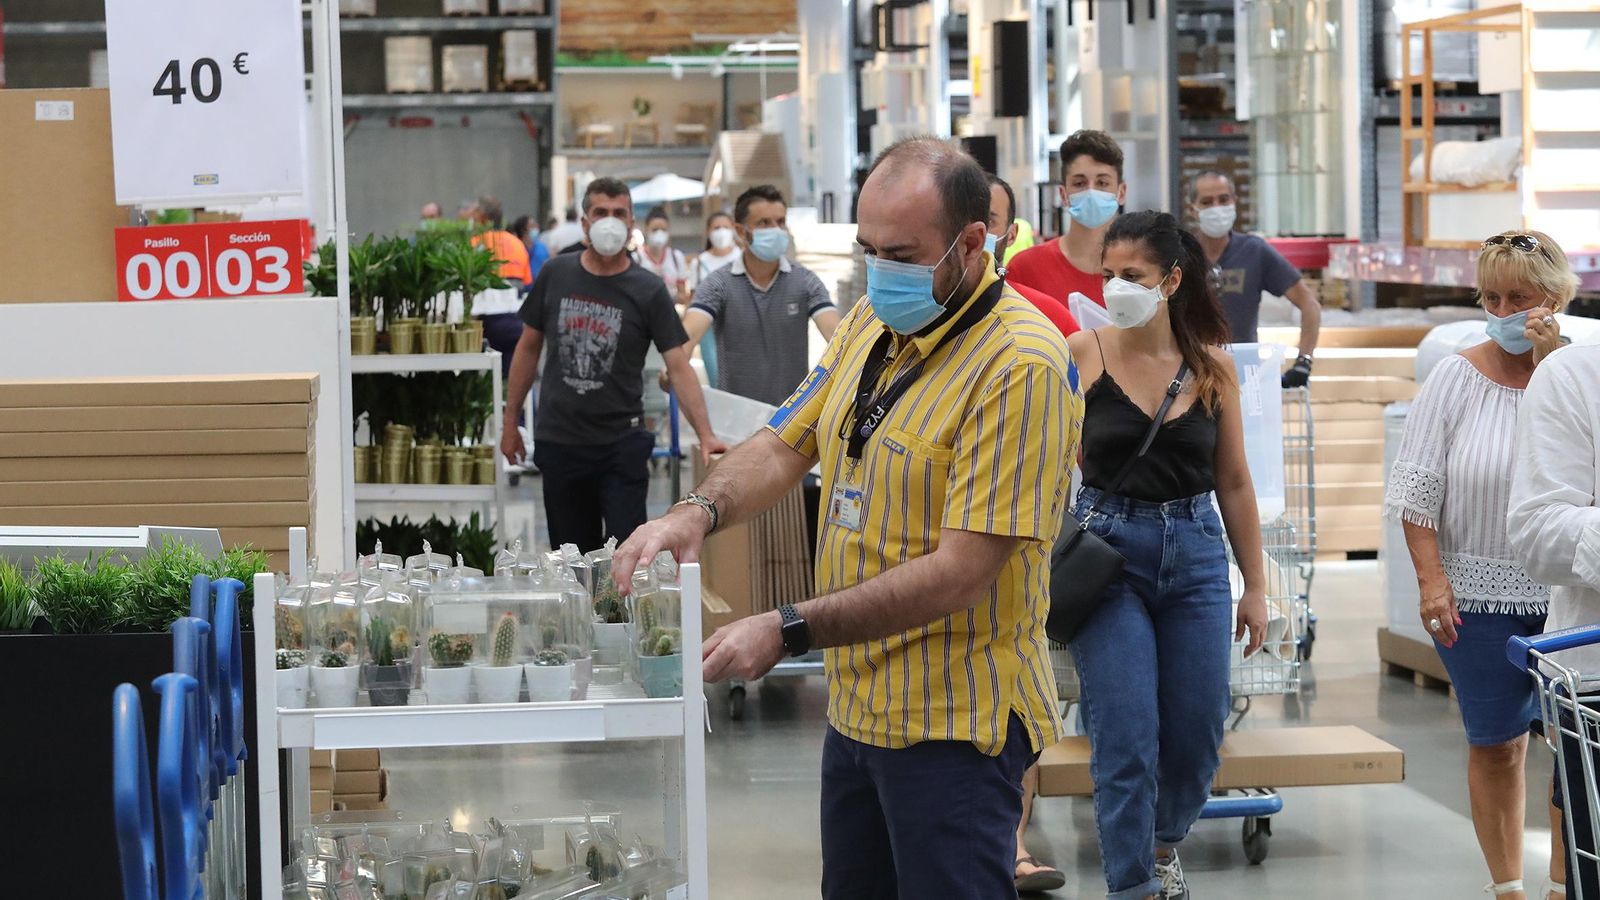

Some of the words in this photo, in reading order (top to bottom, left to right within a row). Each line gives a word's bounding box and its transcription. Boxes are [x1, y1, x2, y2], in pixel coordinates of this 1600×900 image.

[153, 57, 222, 104] 40
[233, 52, 249, 75] €
[144, 238, 180, 249] Pasillo
[229, 232, 271, 244] Sección
[125, 251, 201, 300] 00
[215, 246, 291, 296] 03
